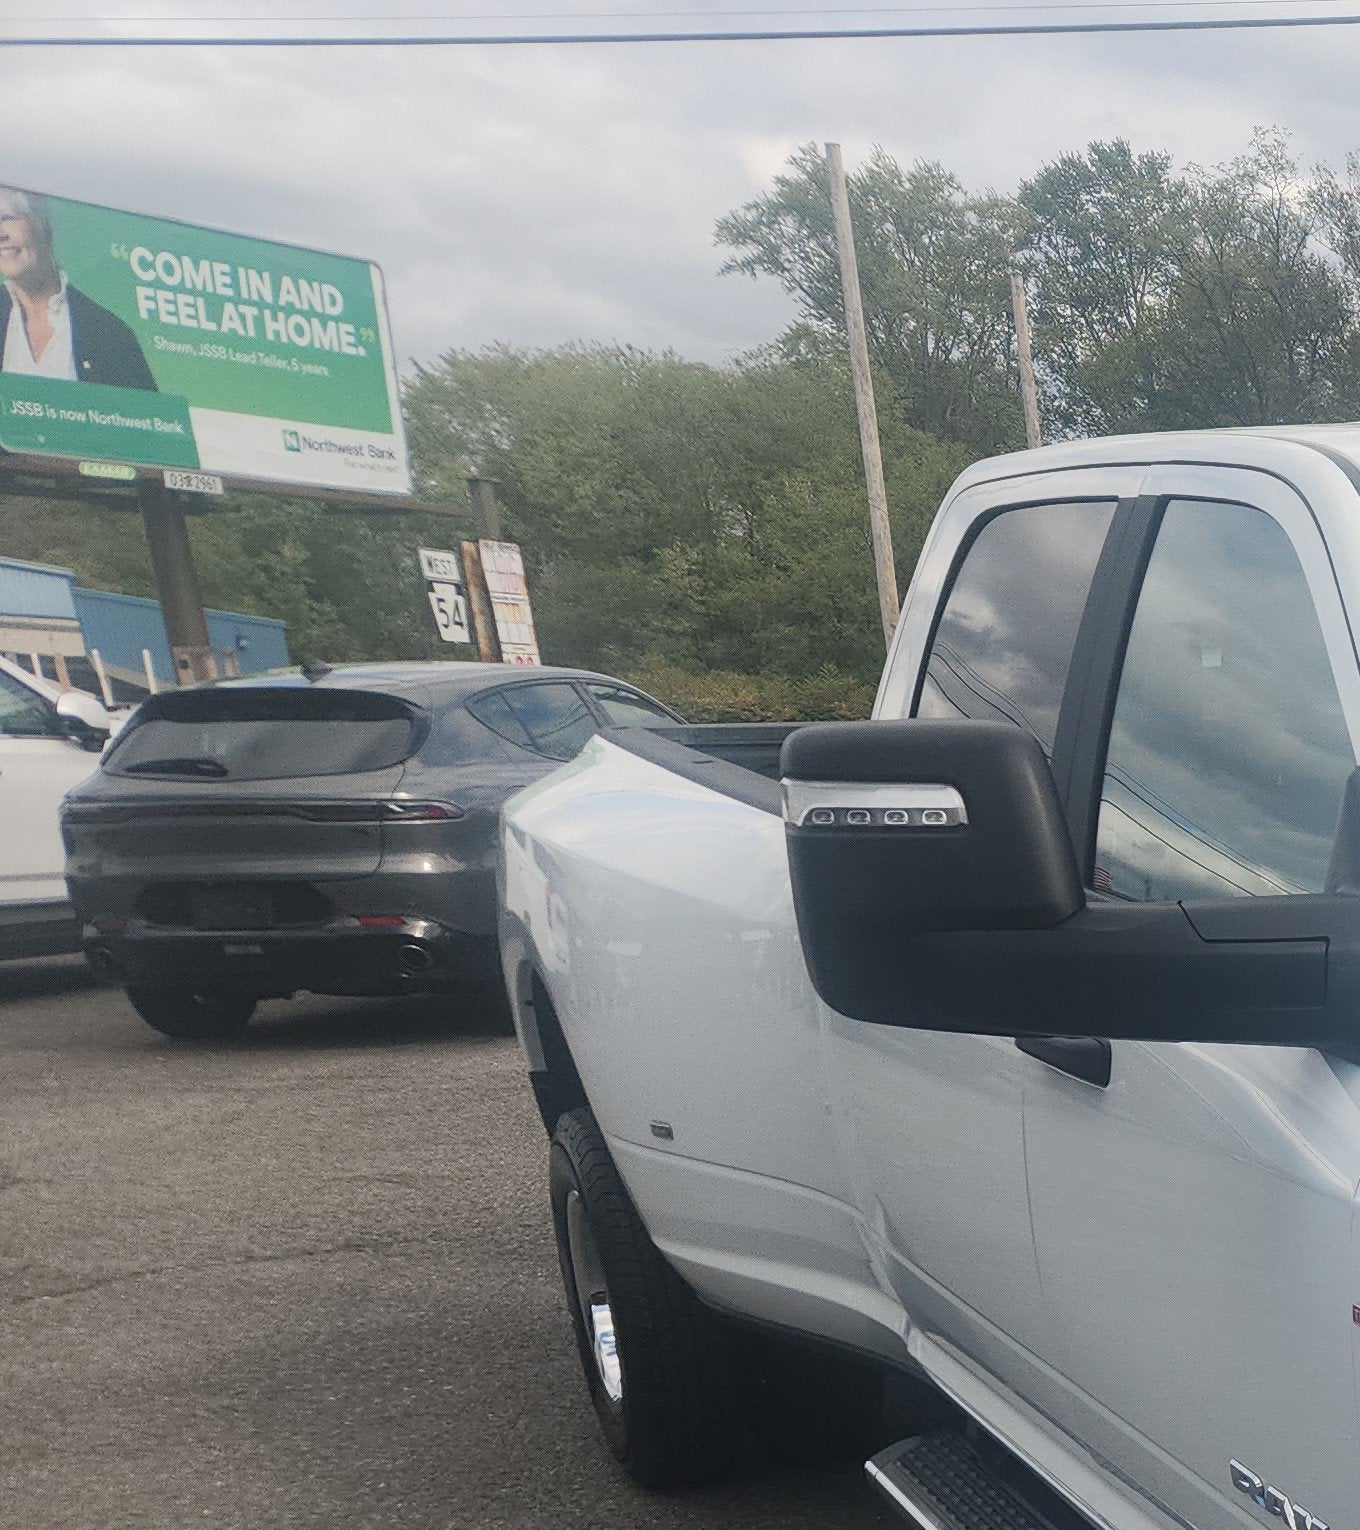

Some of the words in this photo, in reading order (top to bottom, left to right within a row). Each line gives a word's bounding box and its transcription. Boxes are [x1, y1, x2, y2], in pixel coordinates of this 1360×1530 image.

[238, 266, 273, 304] IN
[279, 275, 344, 316] AND
[136, 285, 217, 332] FEEL
[220, 302, 259, 338] AT
[46, 405, 56, 419] is
[60, 411, 86, 422] now
[88, 409, 153, 430] Northwest
[154, 418, 184, 434] Bank
[303, 436, 364, 457] Northwest
[368, 444, 395, 459] Bank
[426, 554, 454, 576] WEST
[436, 597, 465, 631] 54
